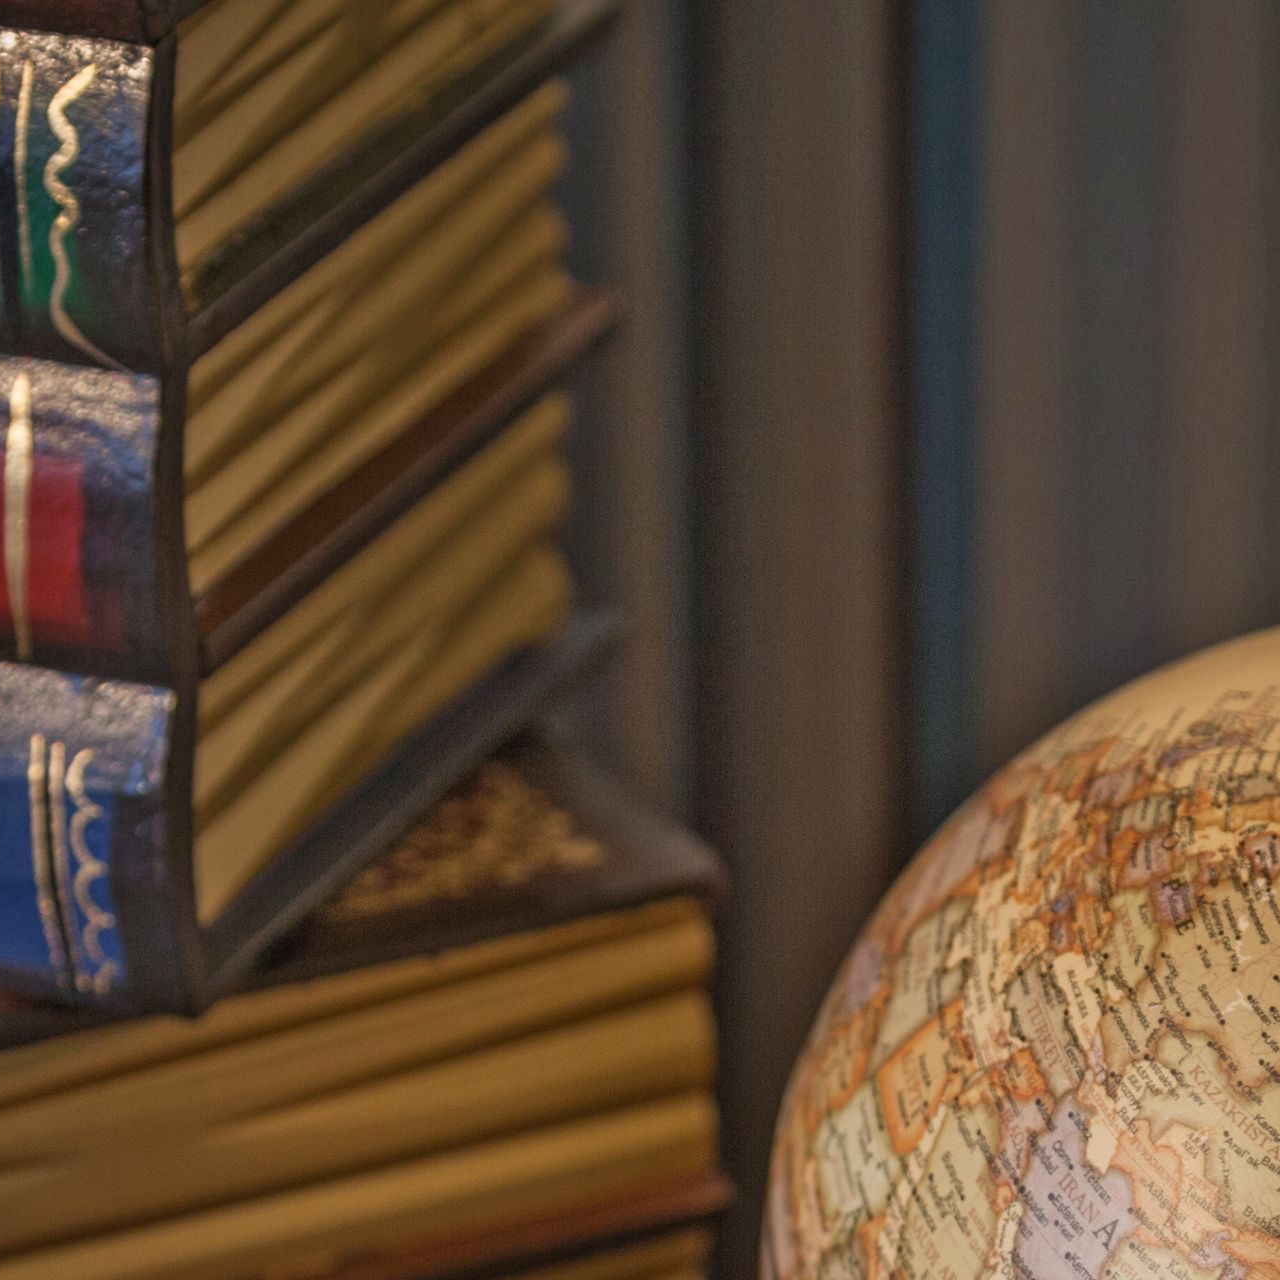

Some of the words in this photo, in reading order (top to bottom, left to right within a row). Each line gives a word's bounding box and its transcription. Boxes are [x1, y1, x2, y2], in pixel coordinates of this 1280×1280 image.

[1028, 1001, 1061, 1068] TURKEY
[1264, 1034, 1280, 1053] Ufa
[1058, 1175, 1101, 1223] IRAN
[1084, 1166, 1112, 1205] Tehran
